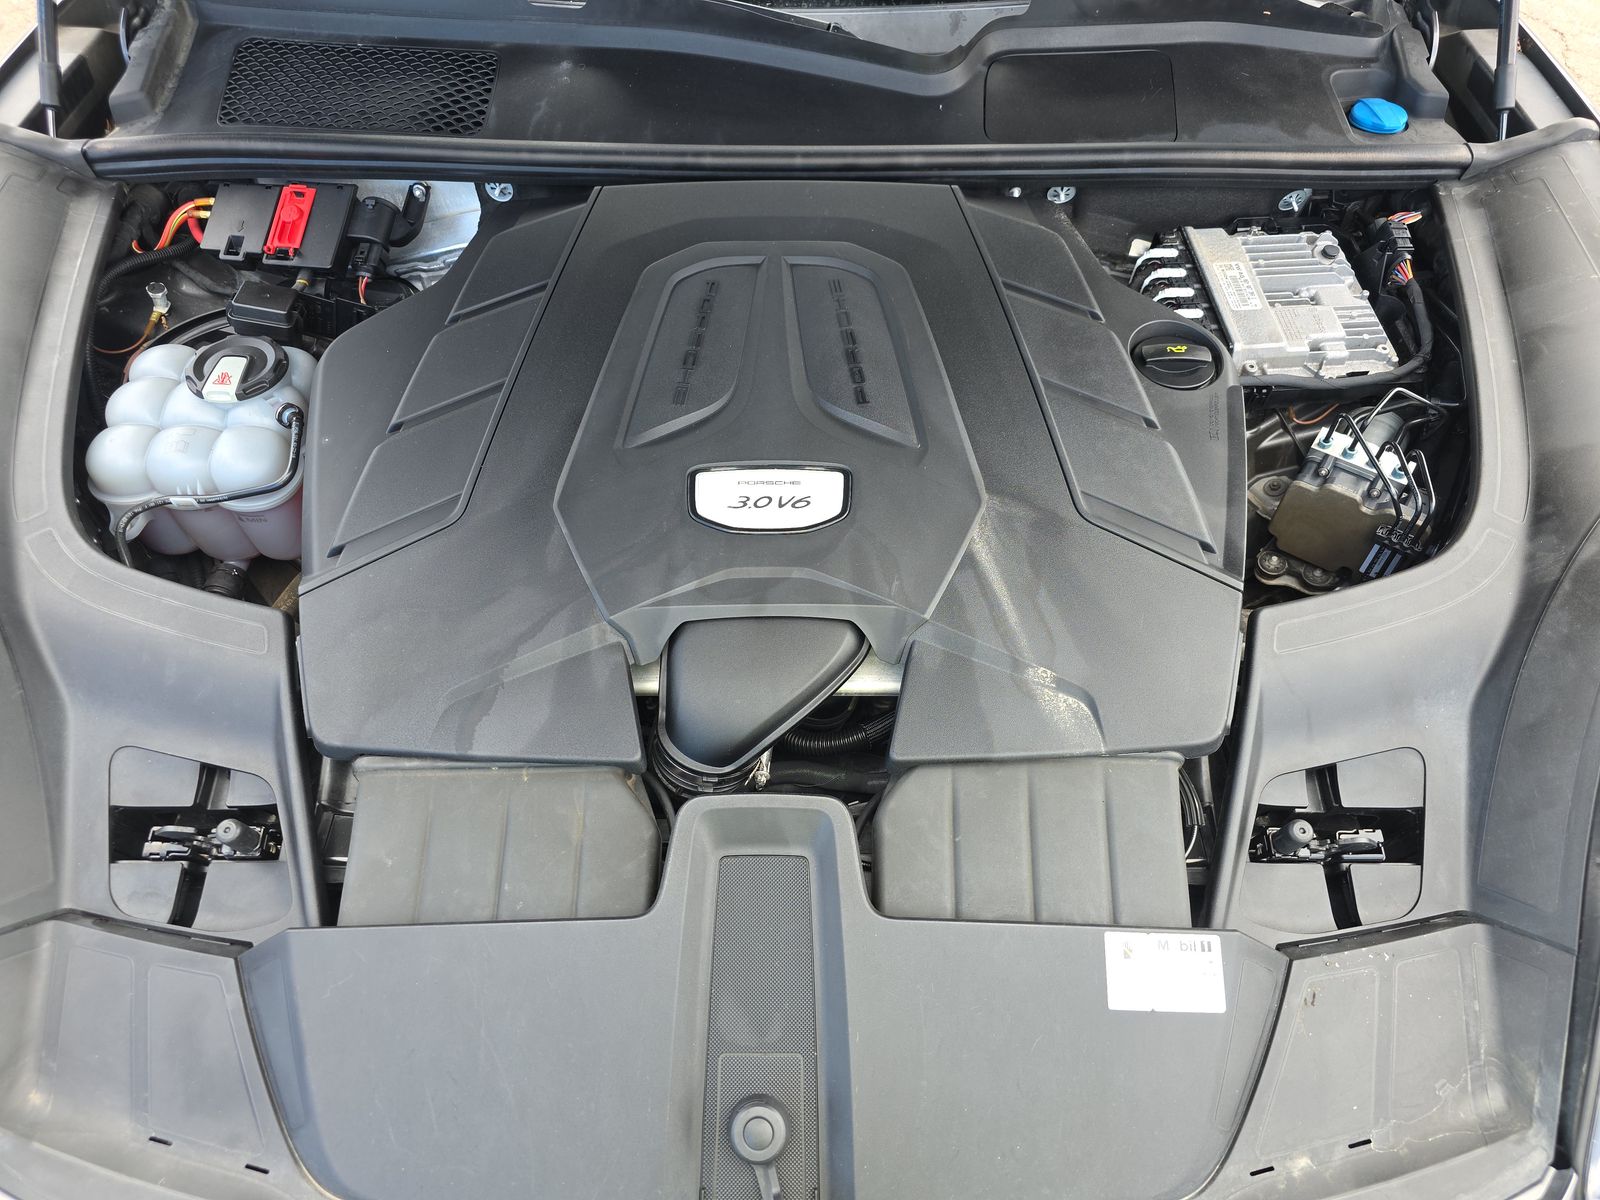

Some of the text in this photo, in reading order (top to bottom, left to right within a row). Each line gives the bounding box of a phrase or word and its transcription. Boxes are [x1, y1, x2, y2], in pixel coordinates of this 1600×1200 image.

[727, 495, 812, 509] 3.0 V6
[1158, 940, 1196, 952] Mbil
